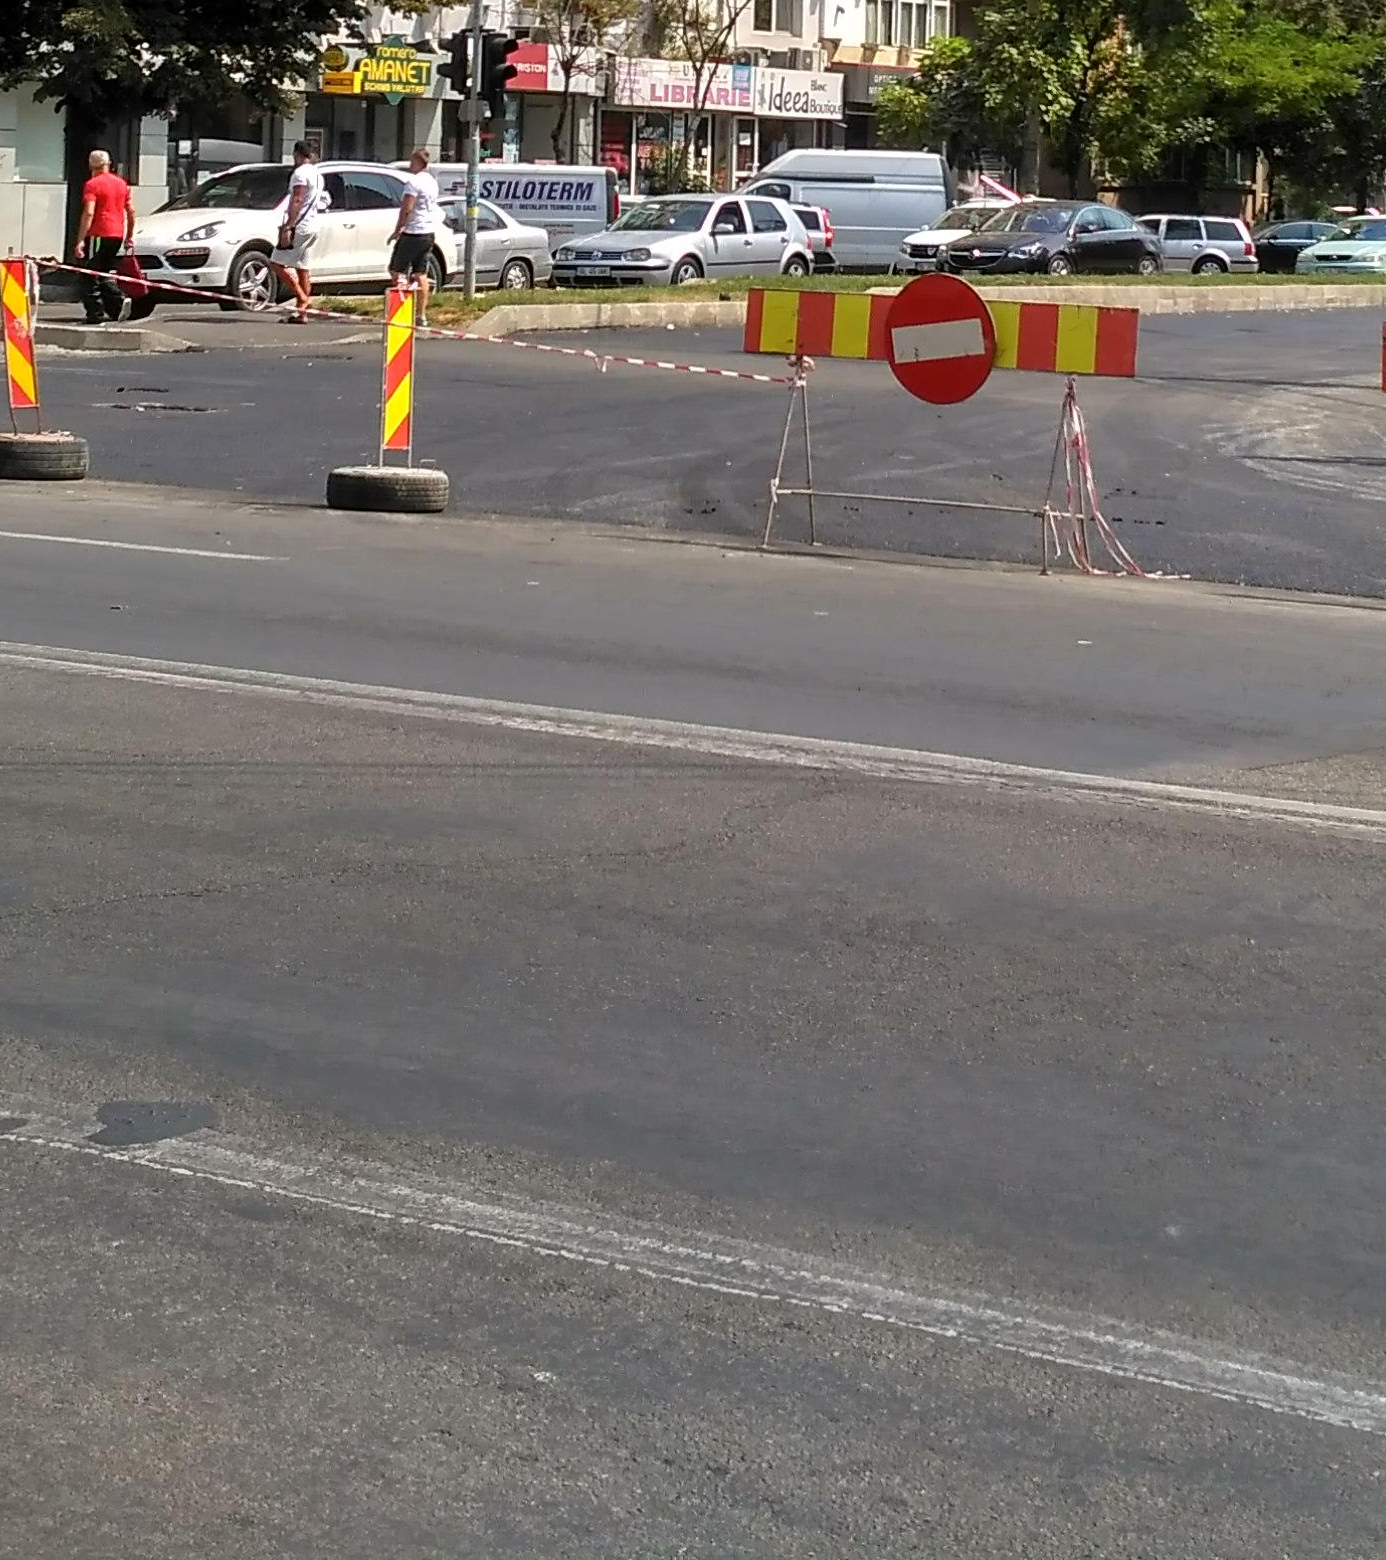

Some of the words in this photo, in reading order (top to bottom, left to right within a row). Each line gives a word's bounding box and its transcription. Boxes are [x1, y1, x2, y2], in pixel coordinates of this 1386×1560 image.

[359, 59, 430, 84] AMANET
[649, 83, 751, 107] LIBRARIE
[768, 72, 809, 113] ideea
[479, 180, 594, 201] STILOTERM
